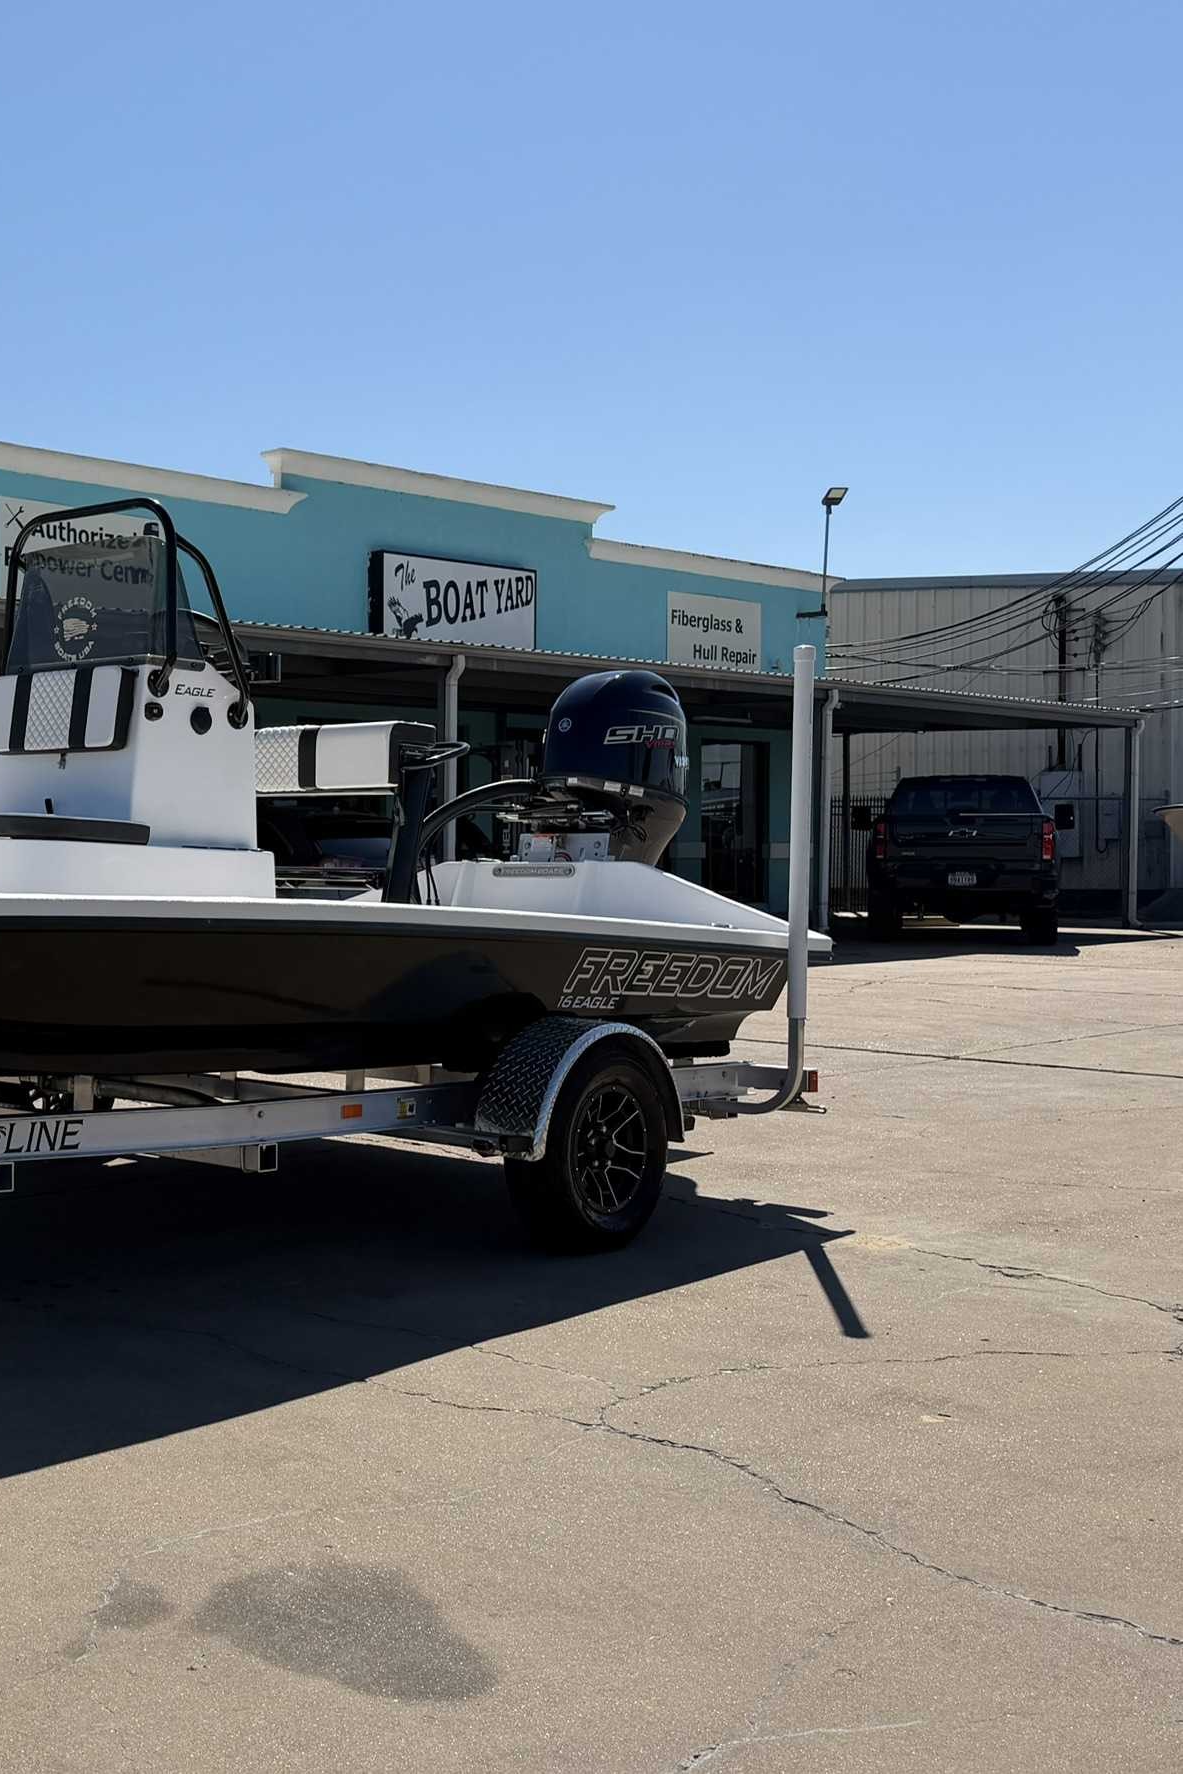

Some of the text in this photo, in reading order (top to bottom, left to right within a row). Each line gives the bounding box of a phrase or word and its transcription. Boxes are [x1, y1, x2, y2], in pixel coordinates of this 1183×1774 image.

[32, 521, 141, 550] Authorize
[100, 557, 154, 586] Cen
[394, 560, 417, 592] The
[423, 574, 535, 628] BOAT YARD
[671, 608, 744, 634] Fiberglass &
[693, 643, 757, 666] Hull Repair
[175, 683, 216, 698] EAGLE
[603, 724, 680, 745] SHO
[563, 947, 784, 1000] FREEDOM
